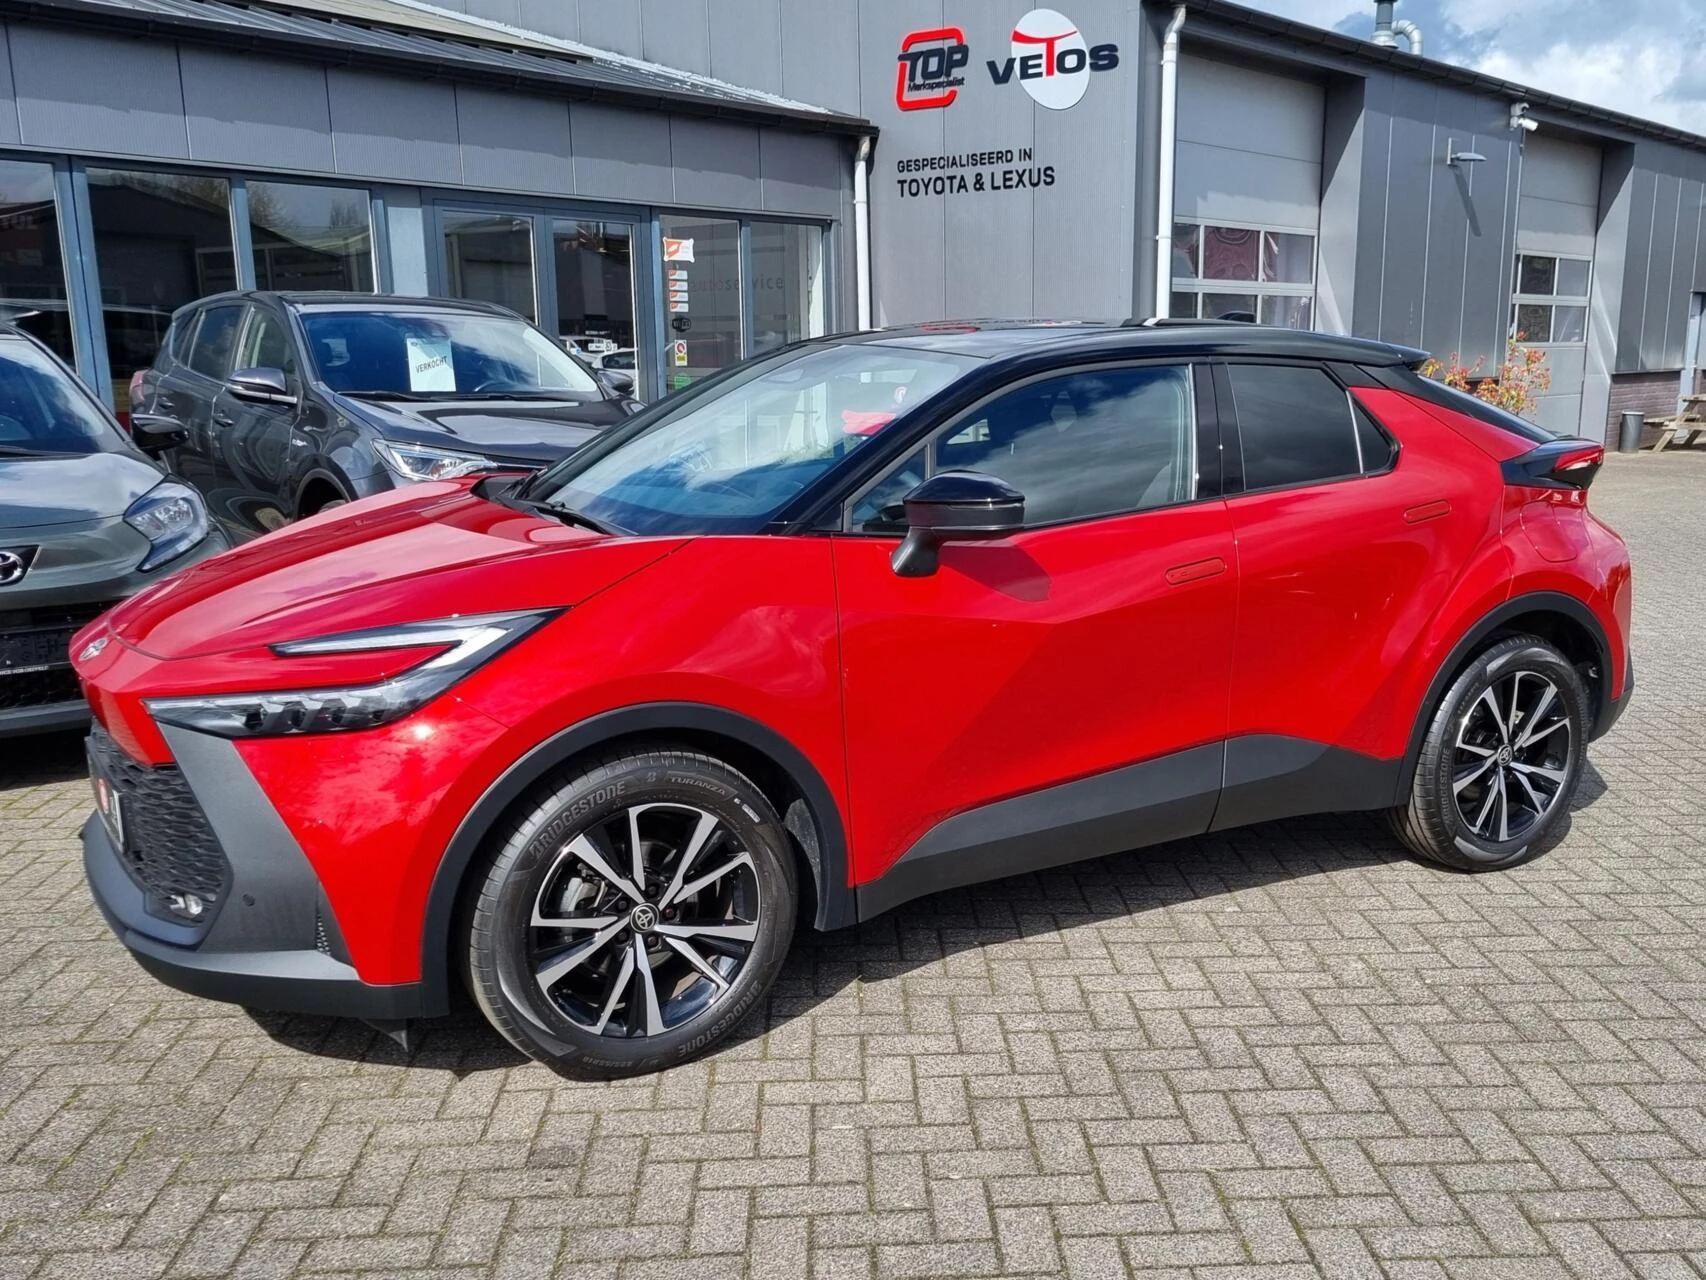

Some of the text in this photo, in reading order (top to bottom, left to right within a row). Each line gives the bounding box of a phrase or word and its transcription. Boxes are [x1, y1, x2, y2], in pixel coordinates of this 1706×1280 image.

[898, 44, 969, 83] TOP
[986, 30, 1120, 86] VETOS
[907, 76, 965, 92] Merkspecialist
[897, 148, 1032, 173] GESPECIALISEERD IN
[897, 166, 1055, 198] TOYOTA & LEXUS
[415, 355, 448, 373] VERKOCHT
[671, 776, 727, 796] TURANZA
[528, 780, 626, 859] BRIDGESTONE
